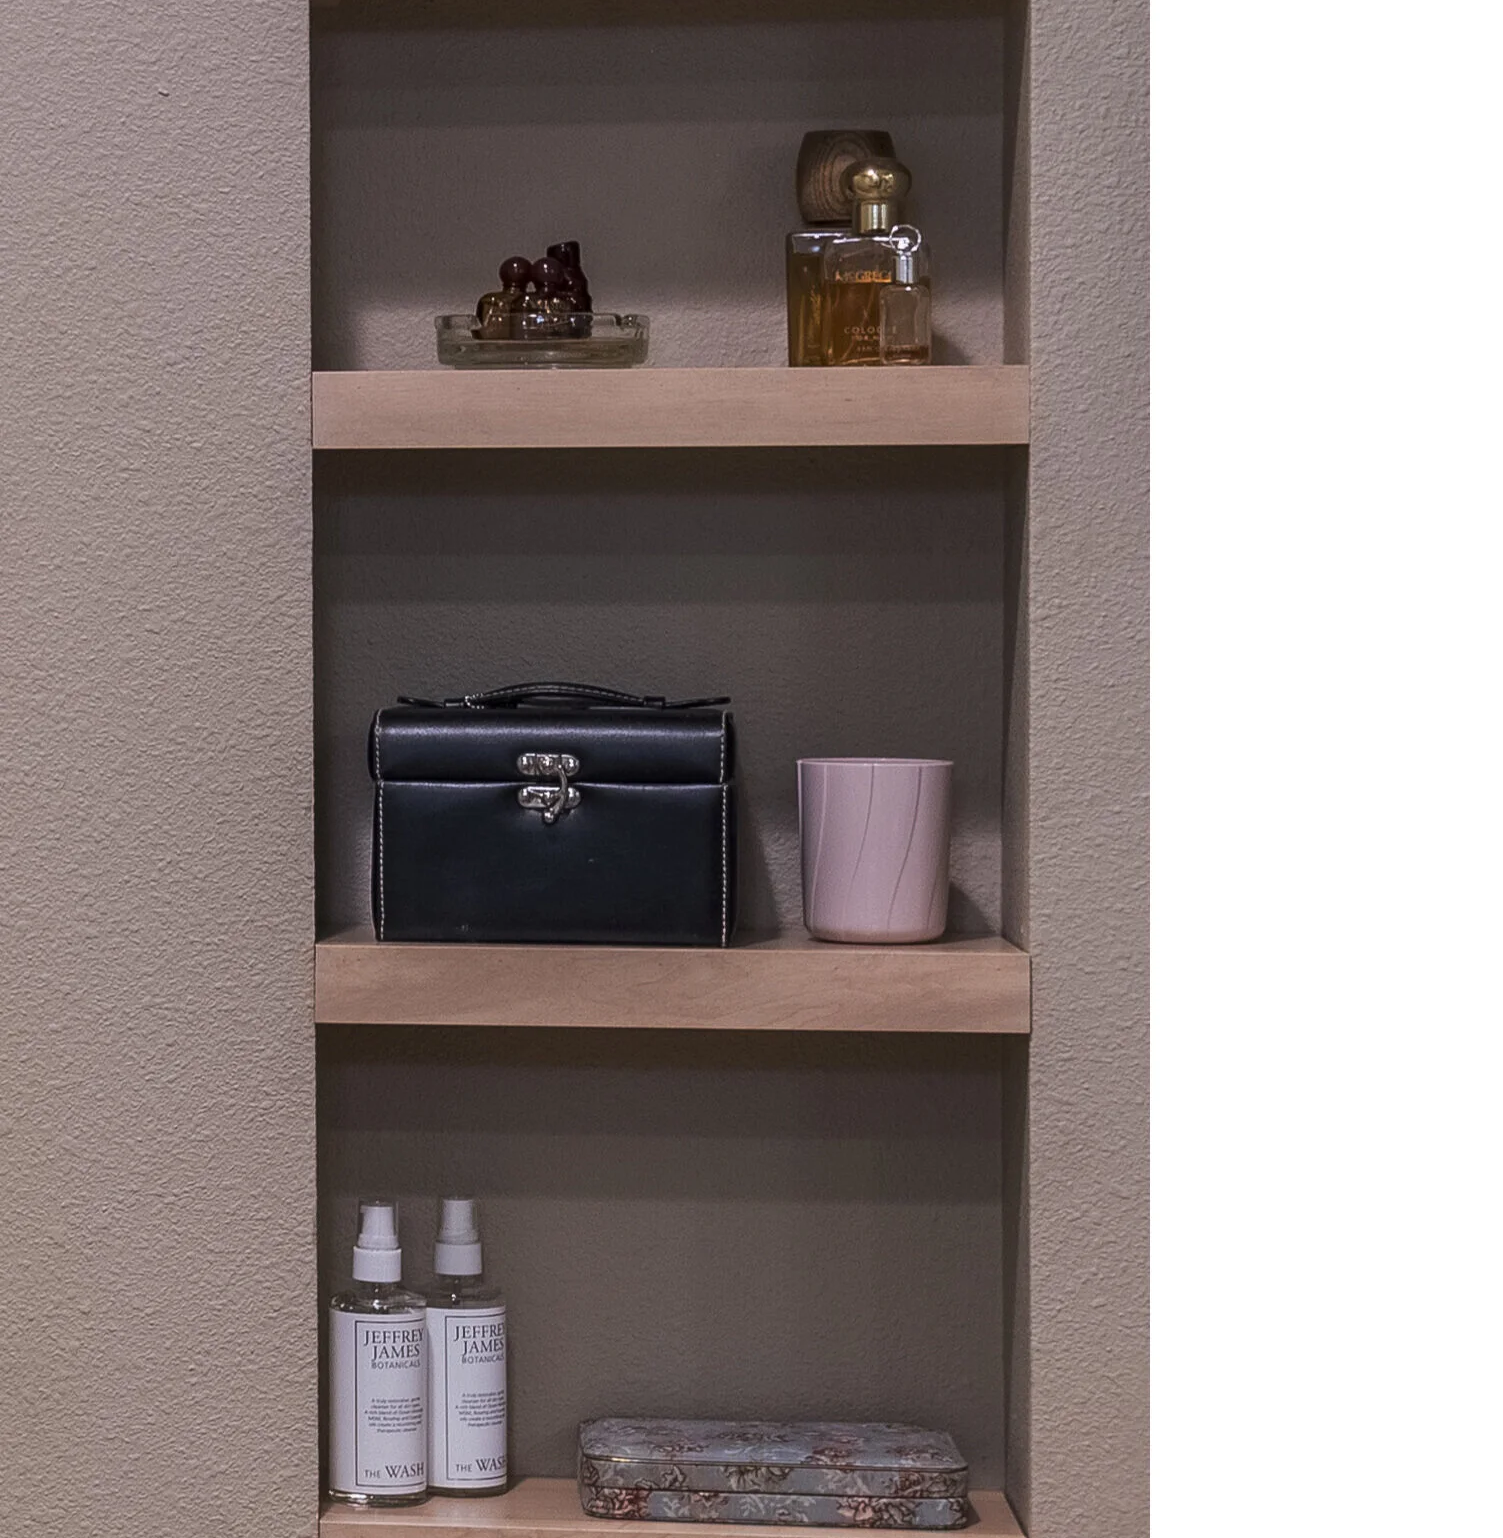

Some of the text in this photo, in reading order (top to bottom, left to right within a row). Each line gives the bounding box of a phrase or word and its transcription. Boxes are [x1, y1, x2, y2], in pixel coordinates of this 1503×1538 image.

[363, 1328, 424, 1346] JEFFREY
[371, 1344, 421, 1362] JAMES
[463, 1337, 505, 1356] JAMES
[364, 1461, 425, 1479] THE WASH
[455, 1463, 473, 1473] THE
